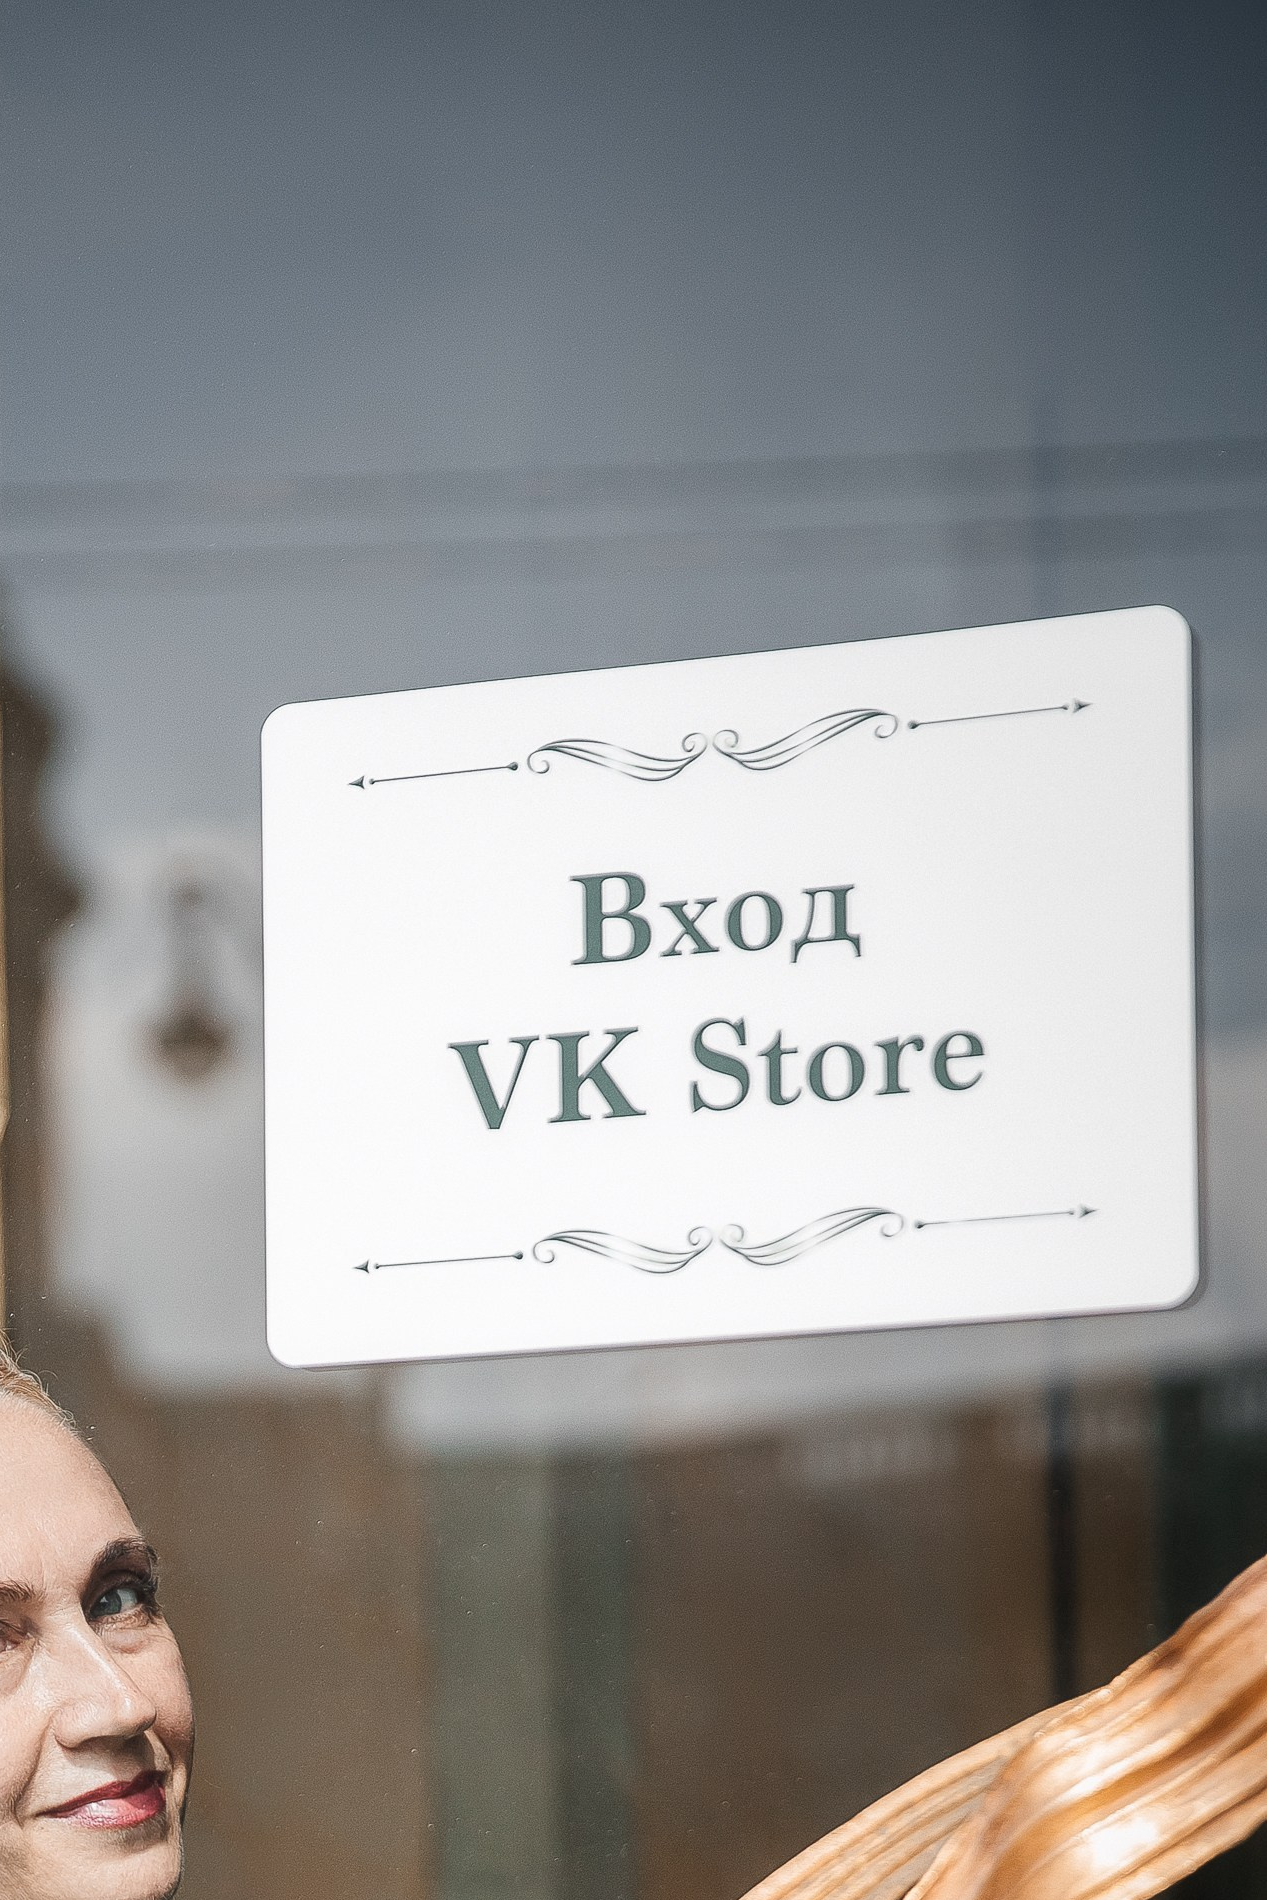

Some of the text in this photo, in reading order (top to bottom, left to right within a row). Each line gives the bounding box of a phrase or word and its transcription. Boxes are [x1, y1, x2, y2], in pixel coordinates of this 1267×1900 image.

[570, 871, 862, 966] Вход
[447, 1018, 986, 1130] VK Store
